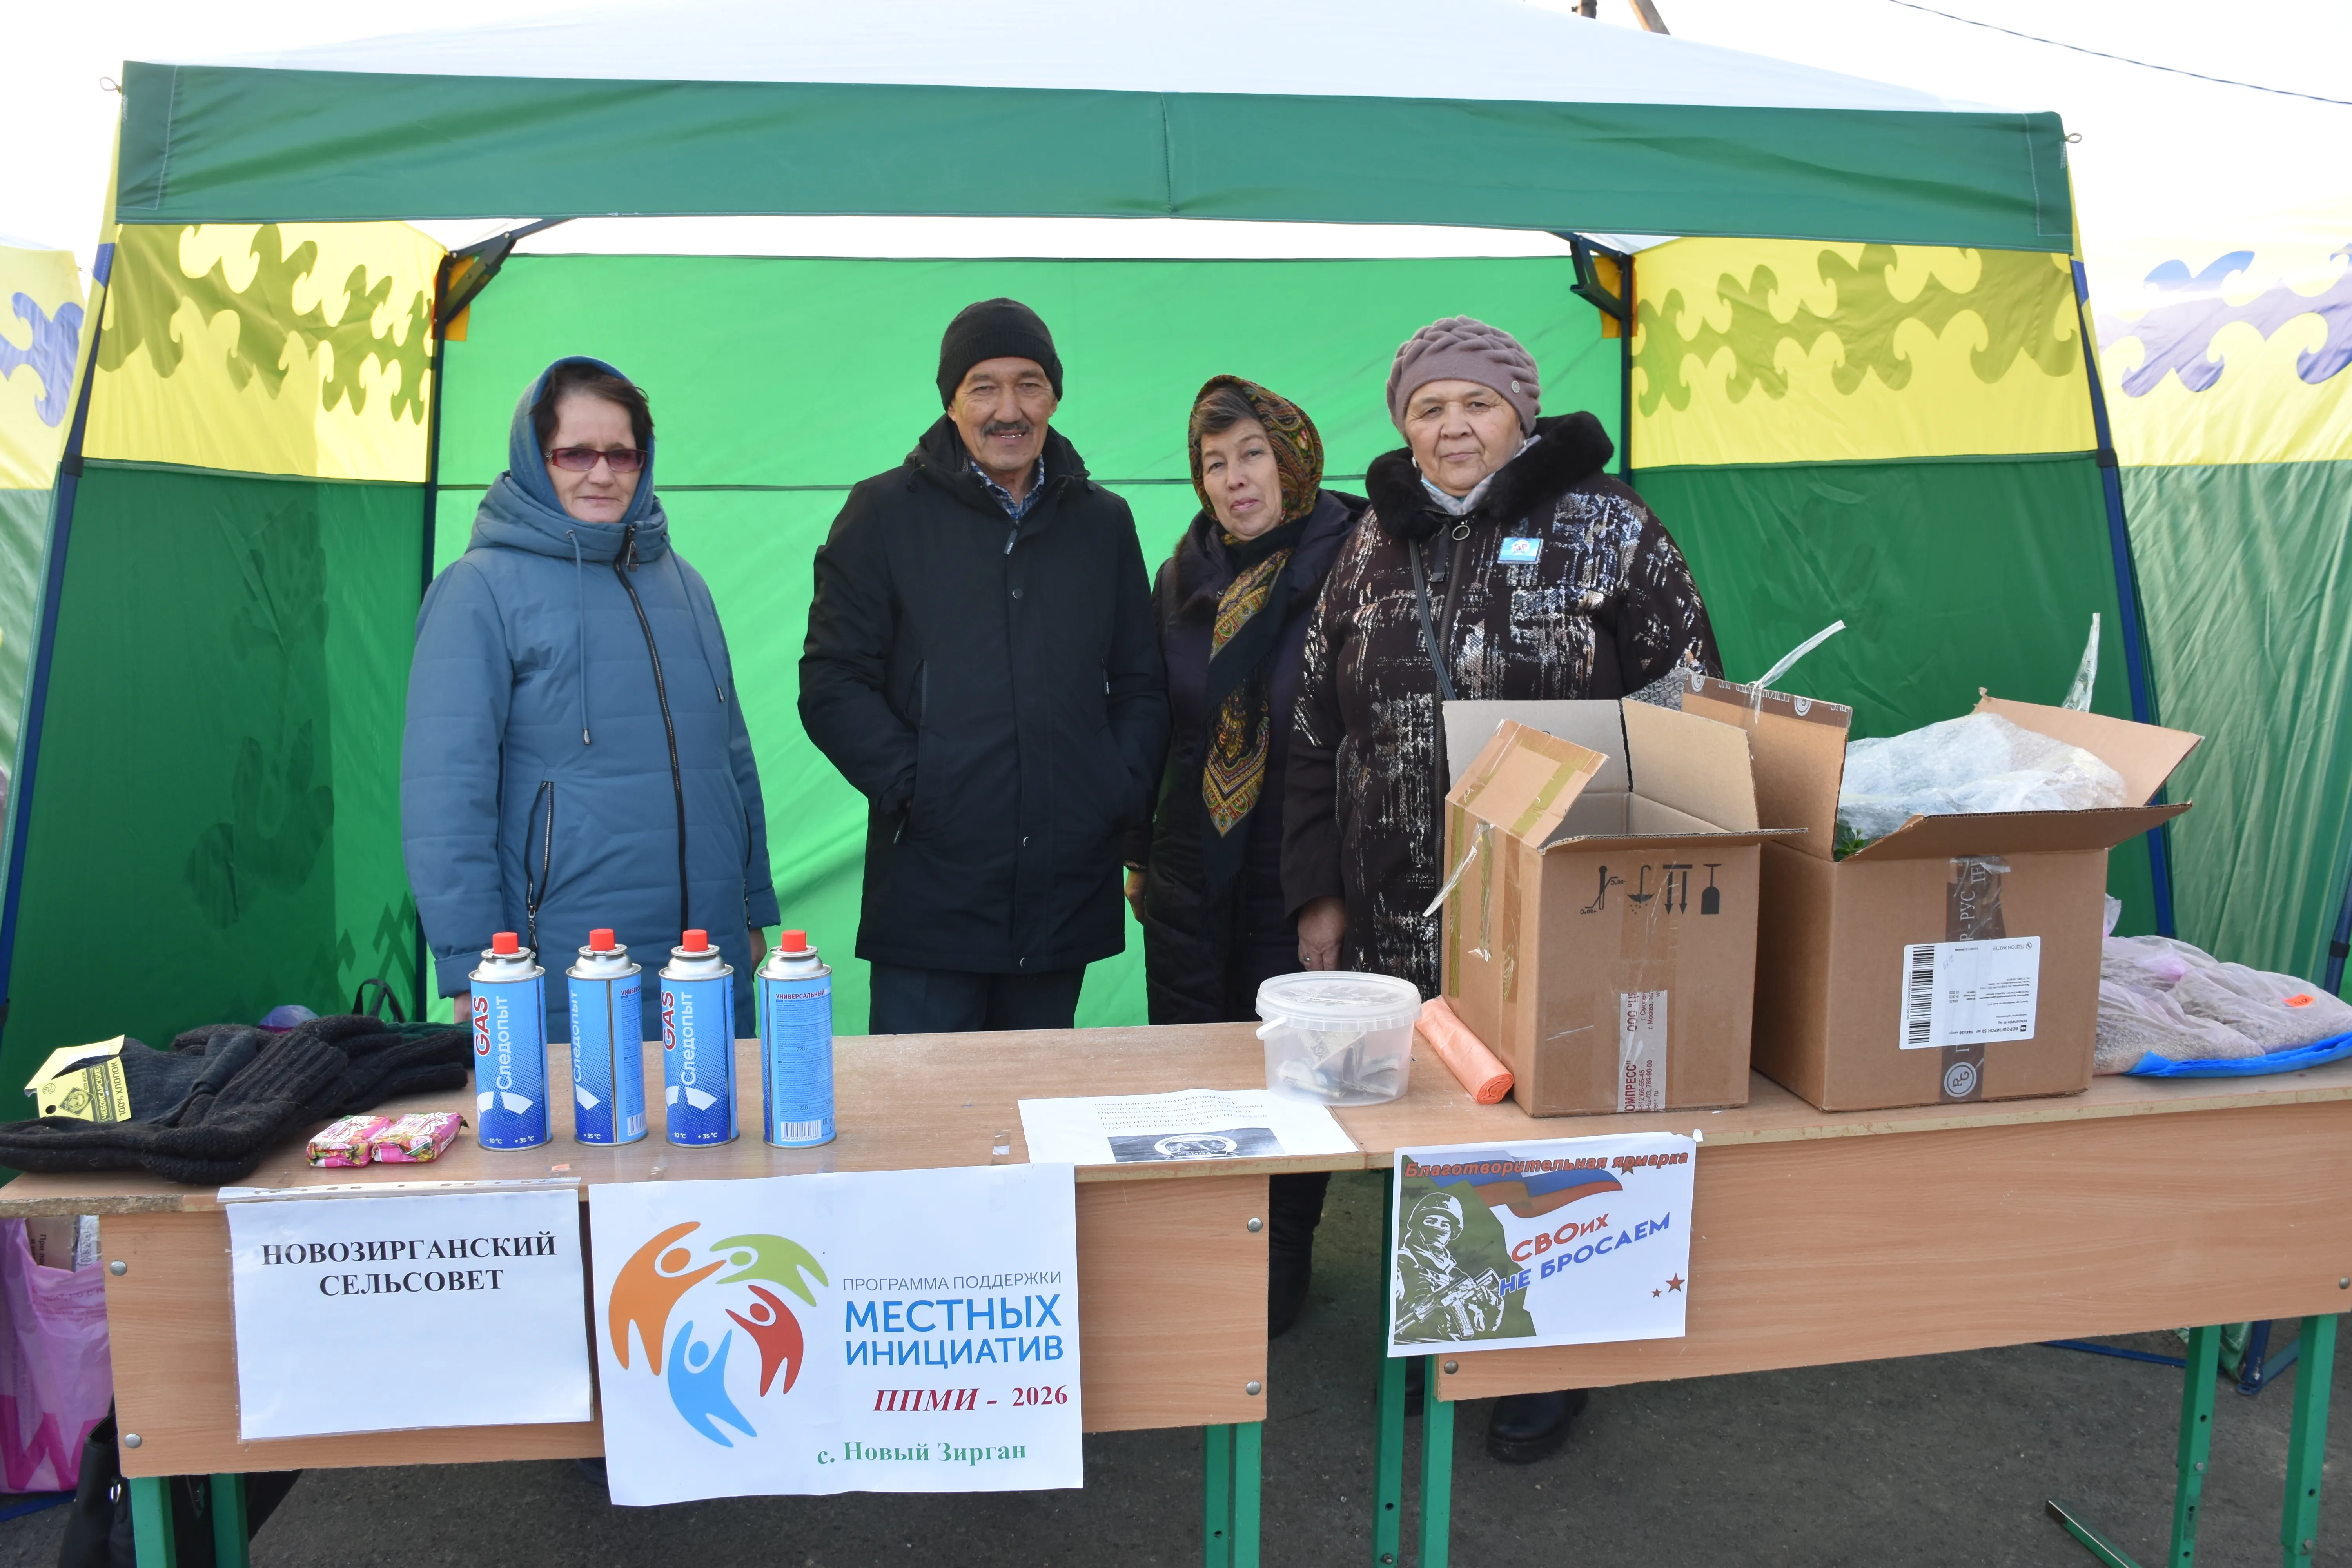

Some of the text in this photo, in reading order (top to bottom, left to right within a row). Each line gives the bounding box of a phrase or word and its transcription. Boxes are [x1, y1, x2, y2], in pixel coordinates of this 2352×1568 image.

[1960, 890, 1975, 922] РУС
[776, 988, 825, 1000] УНИВЕРСАЛЬНЫЙ
[473, 996, 491, 1057] GAS
[571, 989, 581, 1082] Следопыт
[661, 990, 677, 1051] GAS
[496, 996, 512, 1089] Следопыт
[681, 991, 697, 1085] Следопыт
[94, 1067, 108, 1119] ЧЕБОКСАРСКИЕ
[111, 1061, 123, 1095] ХЛОПОК
[117, 1096, 126, 1116] 100%
[1404, 1152, 1689, 1178] Благотворительная ярмарка
[261, 1231, 558, 1265] НОВОЗИРГАНСКИЙ
[1499, 1211, 1670, 1297] НЕ БРОСАЕМ
[1511, 1212, 1610, 1262] СВОих
[319, 1269, 504, 1296] СЕЛЬСОВЕТ
[843, 1271, 1062, 1291] ПРОГРАММА ПОДДЕРЖКИ
[845, 1294, 1062, 1333] МЕСТНЫХ
[846, 1335, 1063, 1370] ИНИЦИАТИВ
[873, 1388, 980, 1412] ППМИ
[1012, 1385, 1068, 1407] 2026
[817, 1441, 1027, 1466] с. Новый Зирган
